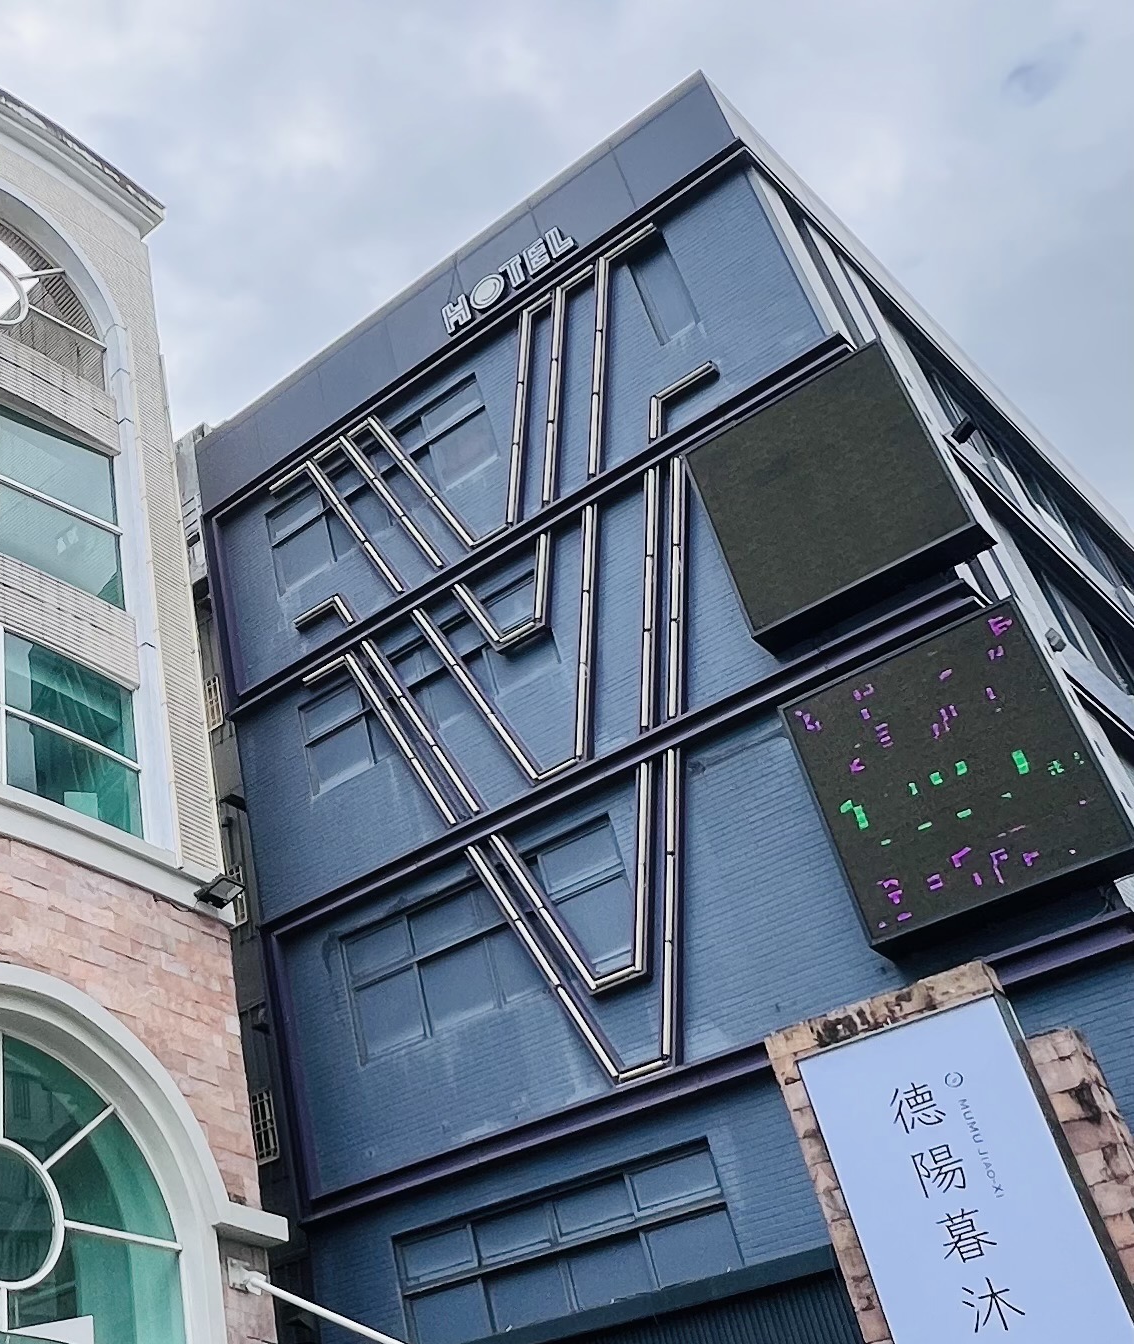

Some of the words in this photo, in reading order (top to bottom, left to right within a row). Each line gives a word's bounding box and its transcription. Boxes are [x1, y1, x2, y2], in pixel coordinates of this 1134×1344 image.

[441, 226, 578, 336] HOTEL
[958, 1098, 984, 1144] MUMU
[977, 1148, 1005, 1199] JIAO-XI
[889, 1082, 1026, 1334] 德陽暮沐
